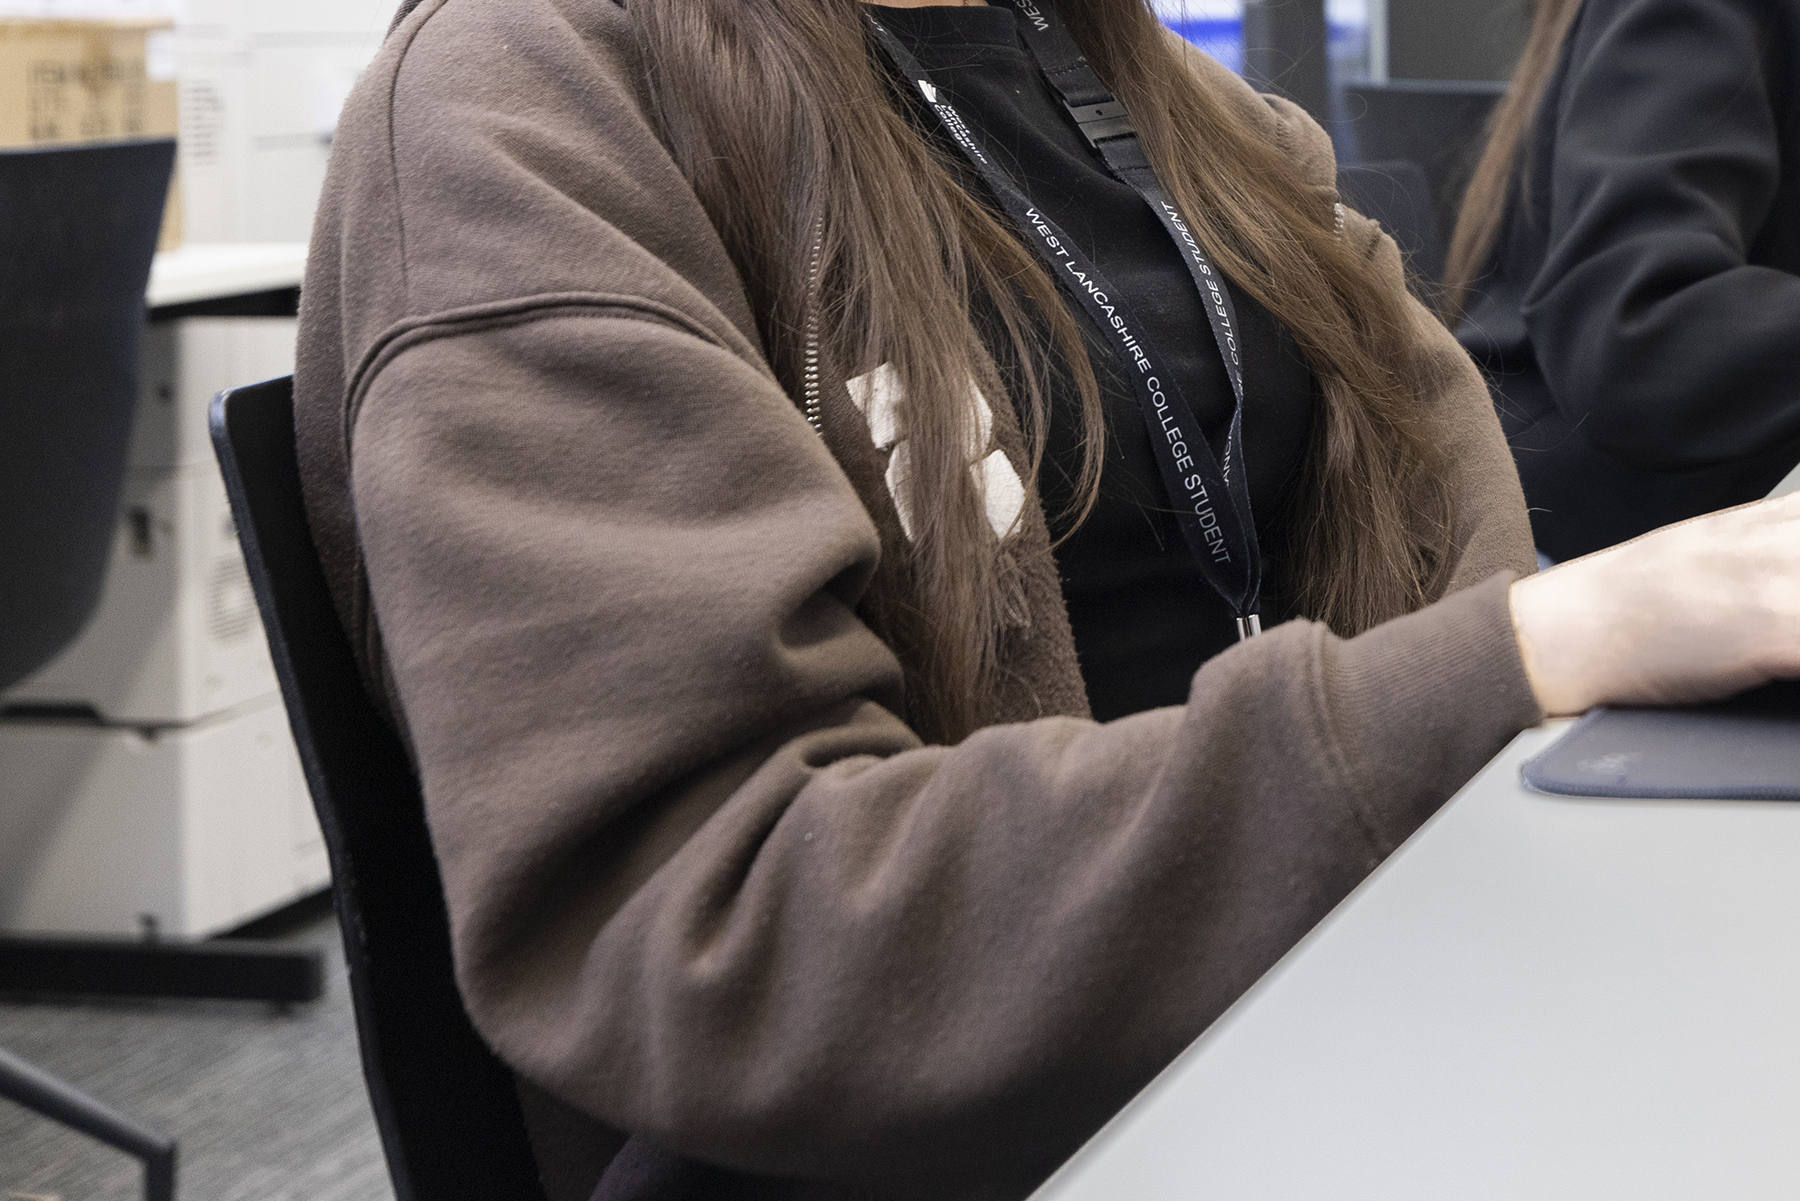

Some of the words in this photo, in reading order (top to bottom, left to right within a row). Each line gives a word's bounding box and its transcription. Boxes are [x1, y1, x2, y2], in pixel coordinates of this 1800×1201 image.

[934, 104, 968, 148] College
[941, 105, 988, 164] Lancashire
[1161, 200, 1211, 275] STUDENT
[1206, 274, 1240, 366] COLLEGE
[1026, 207, 1069, 257] WEST
[1065, 260, 1152, 374] LANCASHIRE
[1147, 376, 1195, 473] COLLEGE
[1184, 473, 1232, 565] STUDENT
